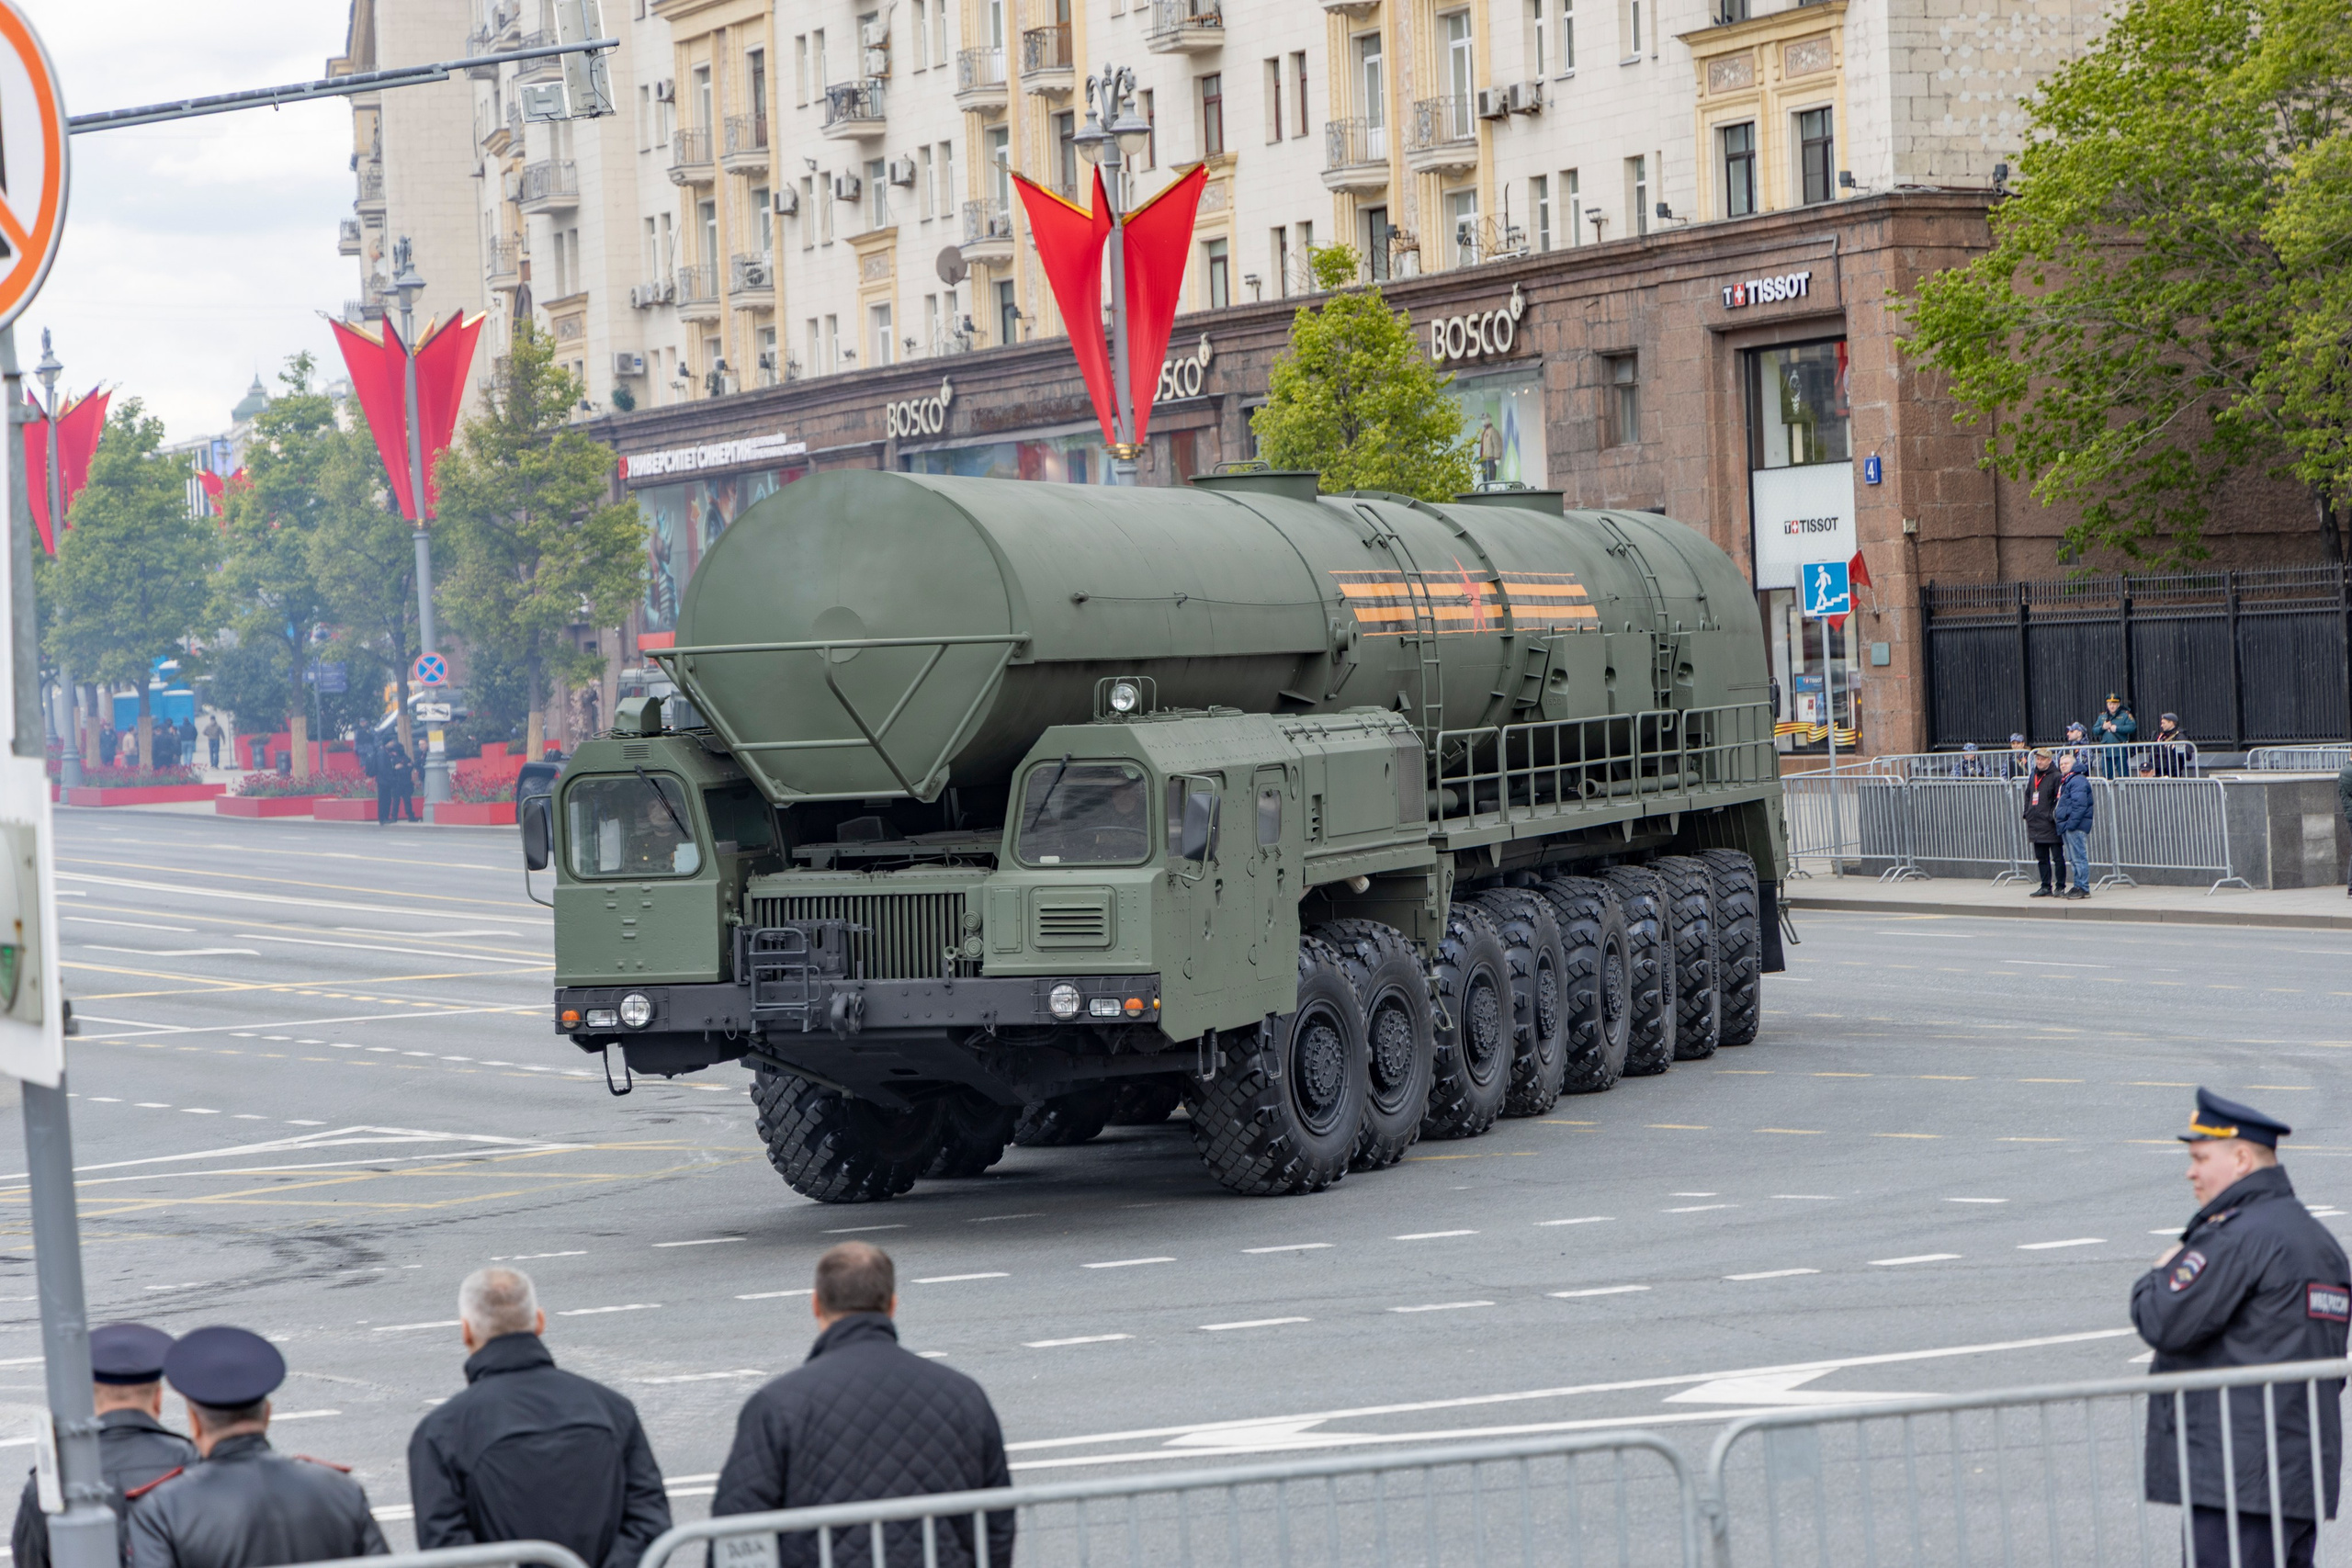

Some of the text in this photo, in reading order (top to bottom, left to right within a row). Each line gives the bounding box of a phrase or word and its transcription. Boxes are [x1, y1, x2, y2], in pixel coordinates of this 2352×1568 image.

[1746, 272, 1810, 304] TISSOT
[1431, 309, 1512, 360] BOSCO
[887, 396, 943, 438] BOSCO
[627, 446, 696, 478] УНИВЕРСИТЕТ
[696, 437, 752, 468] СИНЕРГИЯ
[1867, 461, 1875, 479] 4
[1800, 516, 1838, 533] TISSOT
